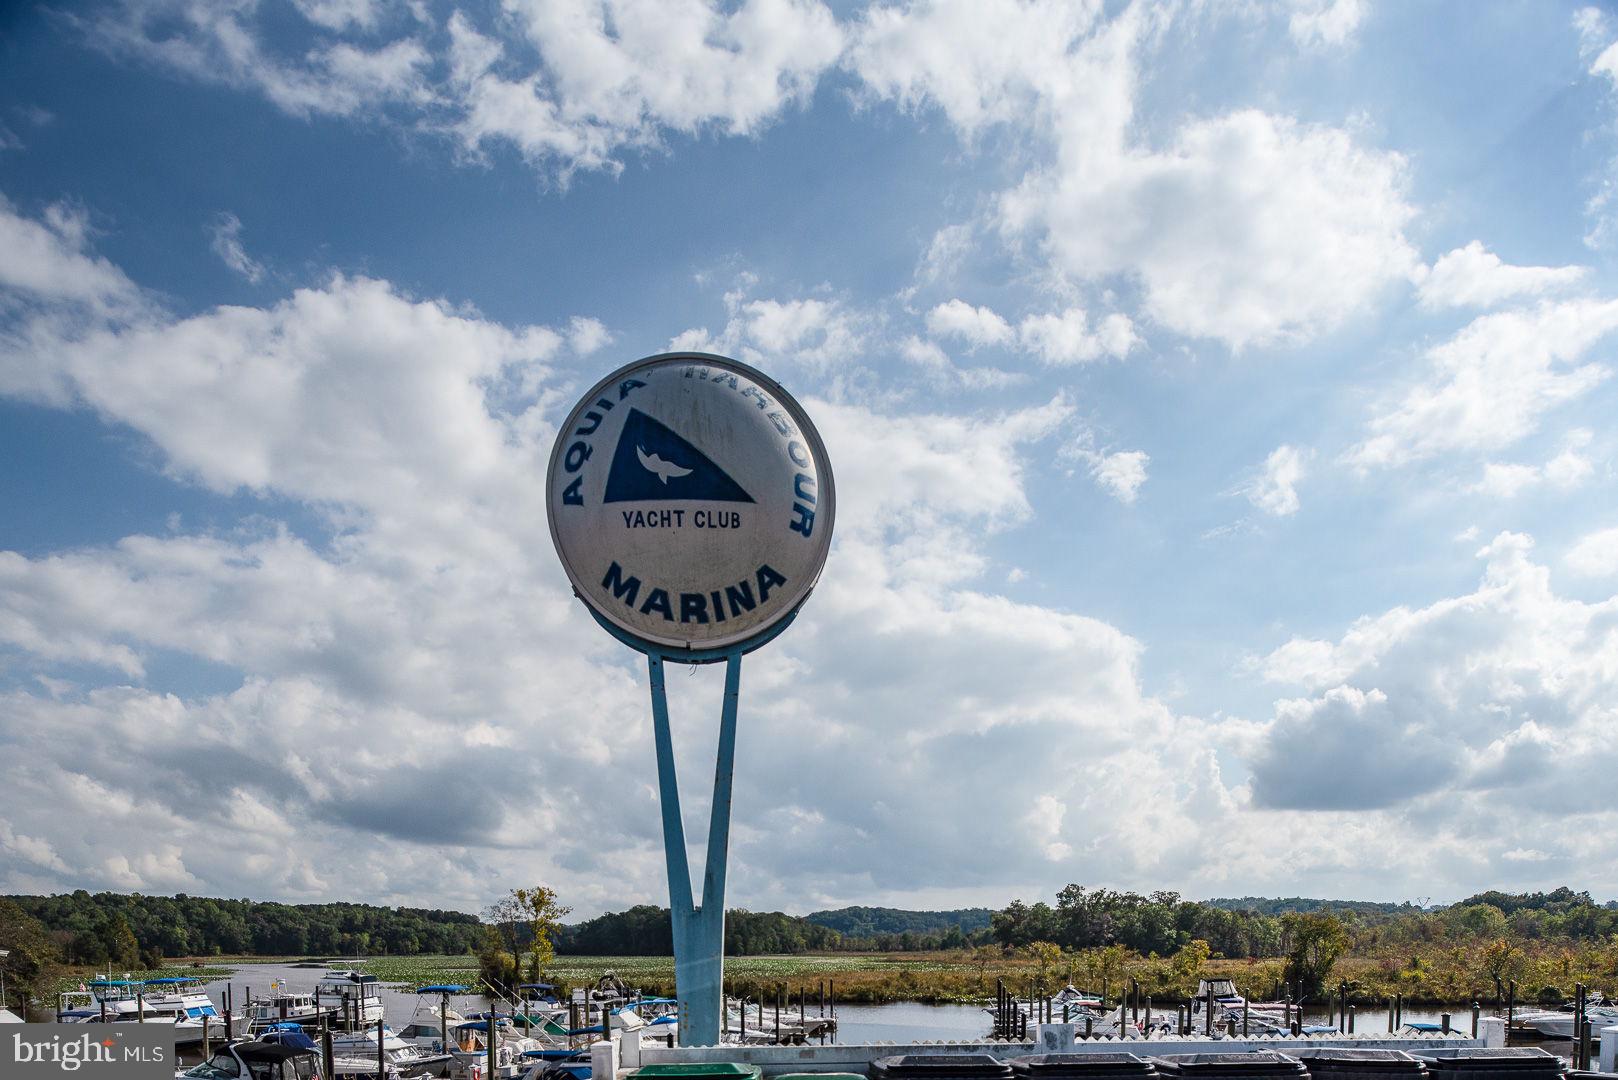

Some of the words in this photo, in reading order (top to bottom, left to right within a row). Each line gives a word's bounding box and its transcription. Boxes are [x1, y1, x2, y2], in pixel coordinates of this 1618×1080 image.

[562, 378, 648, 507] AQUIA
[622, 509, 685, 529] YACHT
[694, 511, 741, 530] CLUB
[601, 560, 788, 624] MARINA
